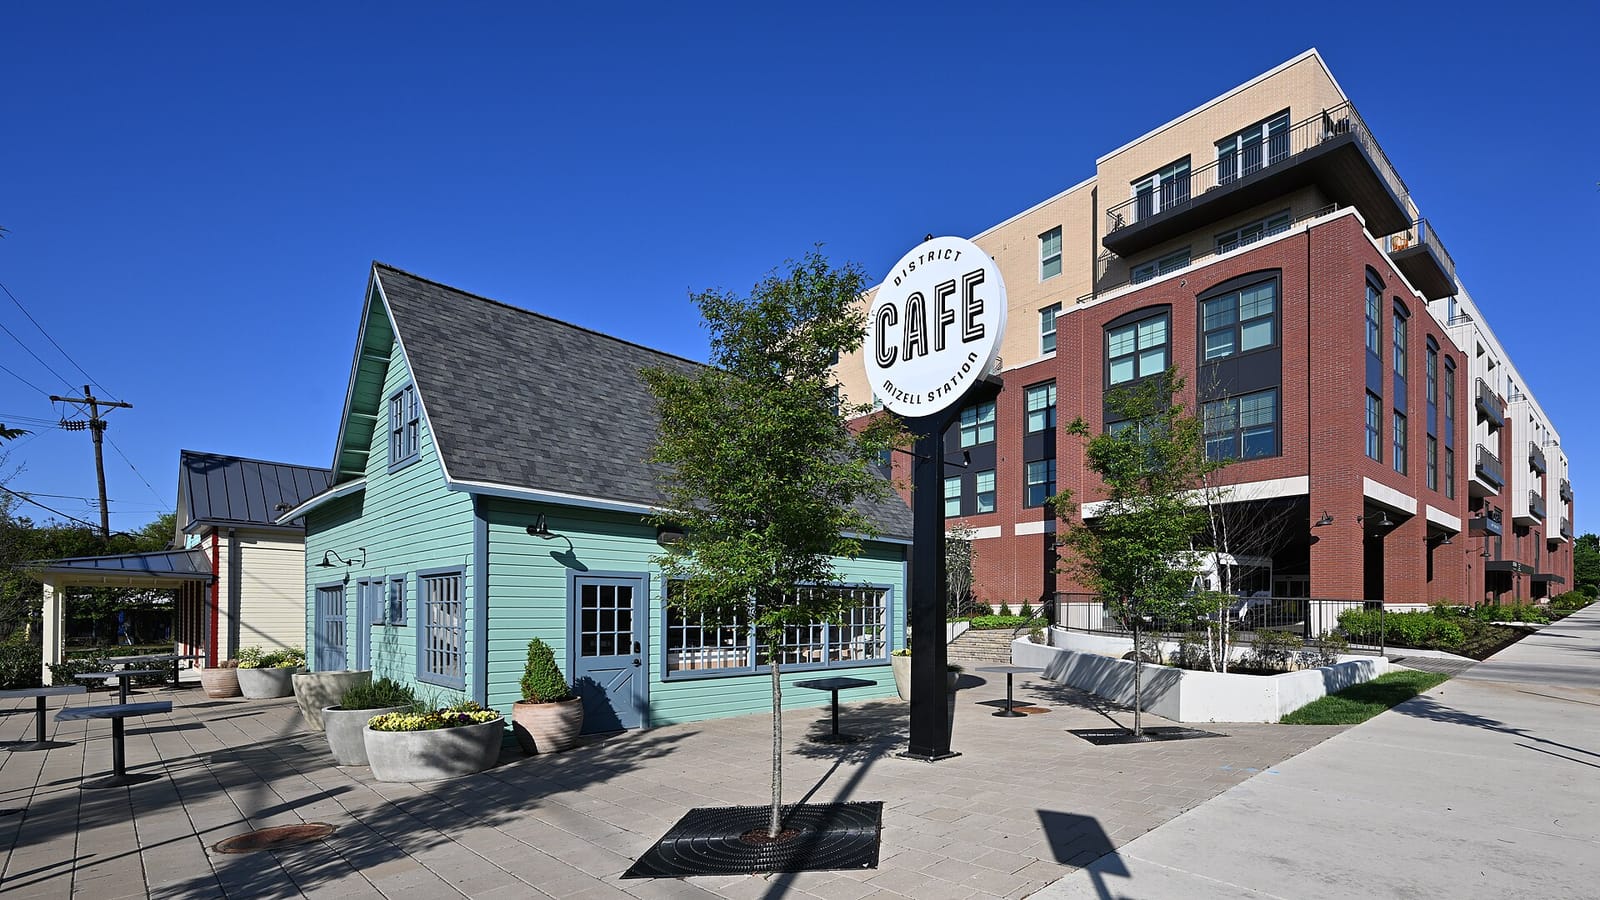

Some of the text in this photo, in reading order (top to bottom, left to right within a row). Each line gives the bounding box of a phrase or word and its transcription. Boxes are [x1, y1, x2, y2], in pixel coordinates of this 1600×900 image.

[894, 249, 962, 287] DISTRICT
[875, 268, 985, 369] CAFE
[883, 352, 978, 404] MIZELL STATION
